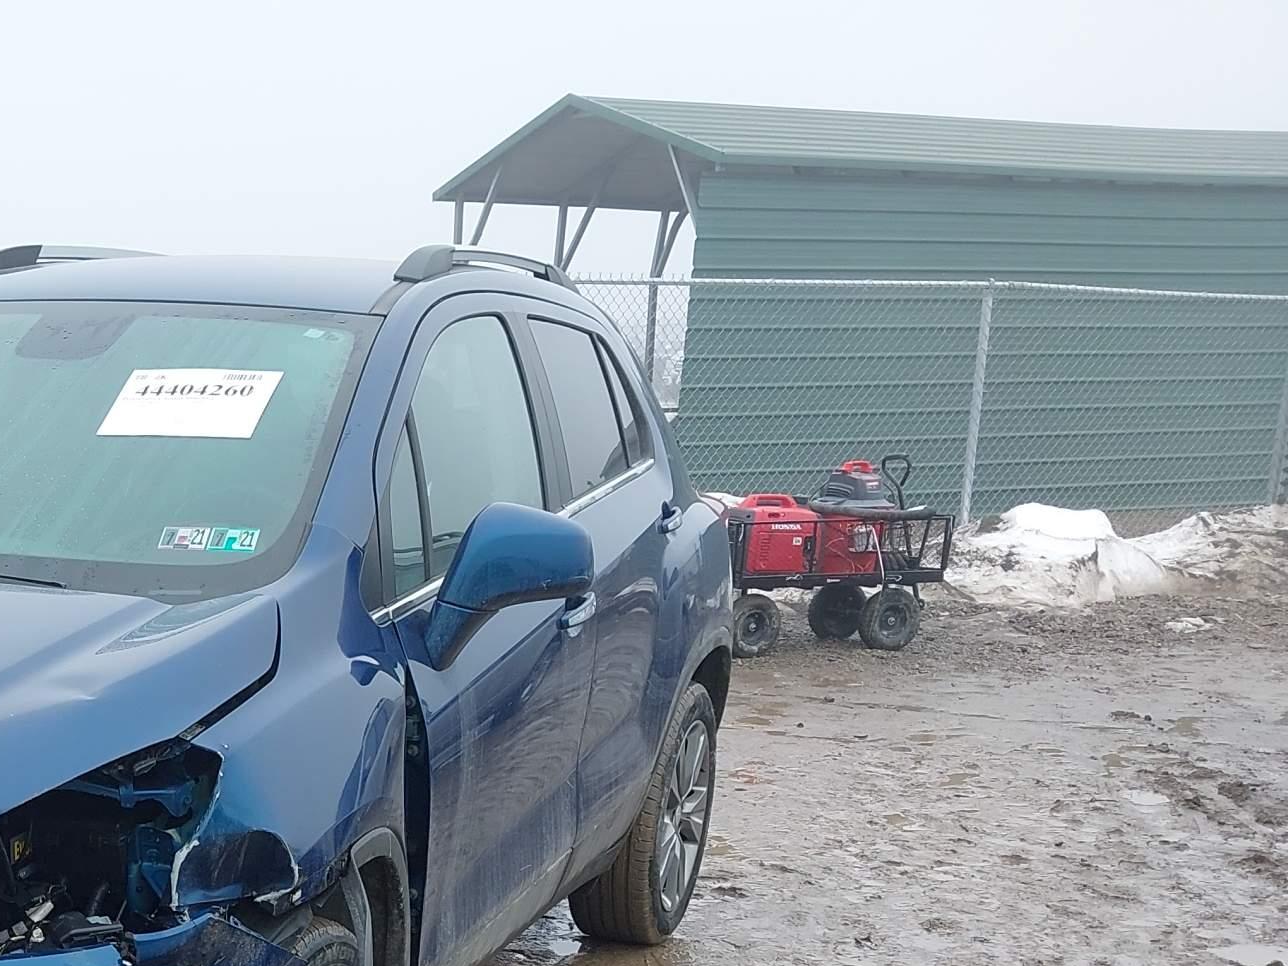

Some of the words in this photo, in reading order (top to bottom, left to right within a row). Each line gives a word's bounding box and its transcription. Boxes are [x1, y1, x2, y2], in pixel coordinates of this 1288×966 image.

[135, 384, 255, 397] 44404260
[191, 529, 205, 545] 21
[240, 531, 255, 547] 21
